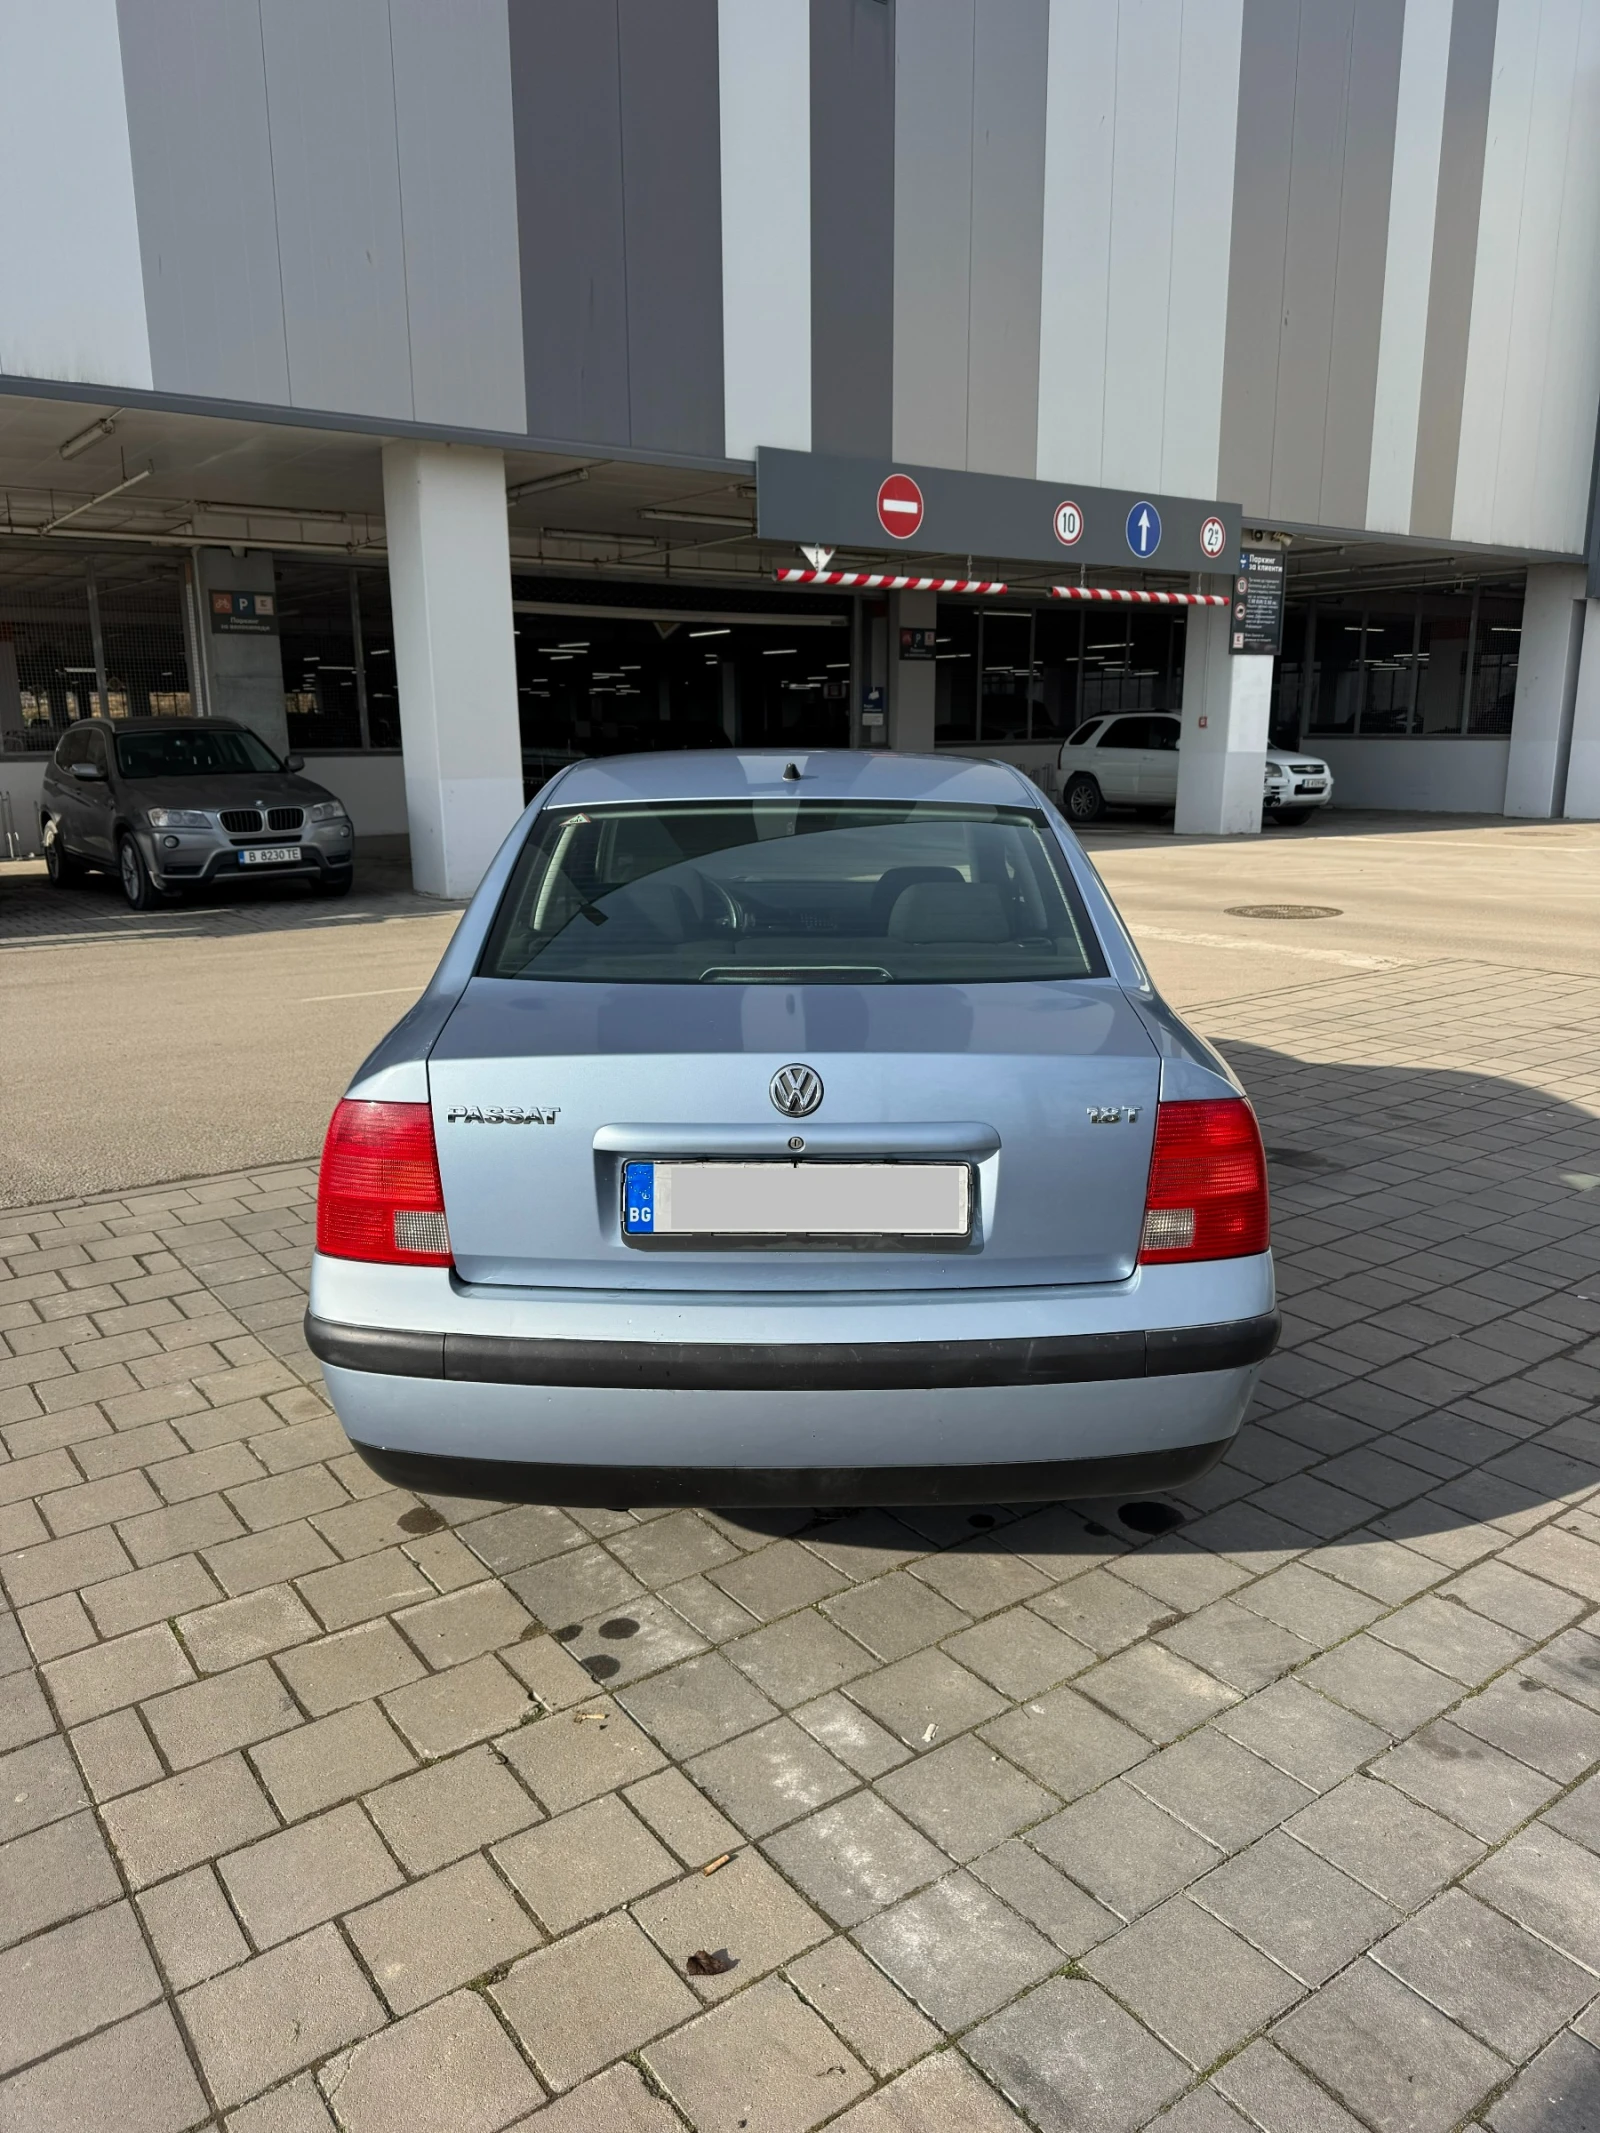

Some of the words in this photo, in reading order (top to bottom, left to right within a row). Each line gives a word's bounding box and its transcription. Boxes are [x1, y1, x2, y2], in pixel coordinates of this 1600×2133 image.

[1063, 512, 1076, 534] 10
[1249, 554, 1276, 565] Паркинг
[1249, 563, 1257, 571] за
[239, 598, 248, 610] P
[261, 850, 285, 860] 8230
[287, 849, 299, 859] TE
[447, 1105, 562, 1125] PASSAT
[629, 1206, 652, 1223] BG
